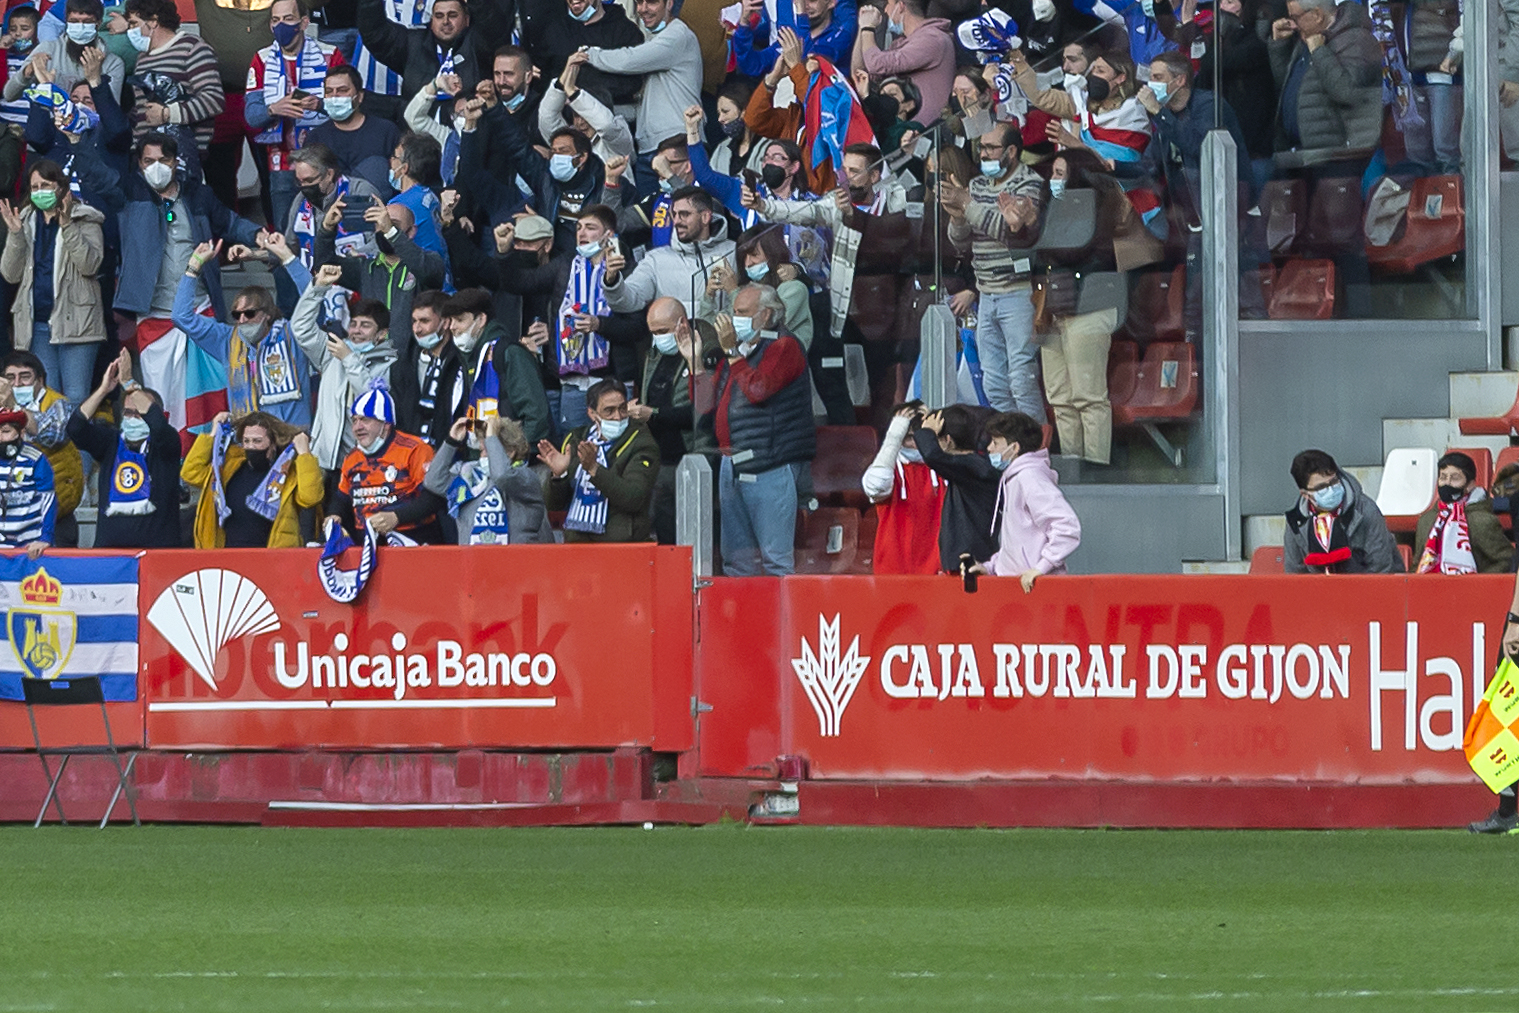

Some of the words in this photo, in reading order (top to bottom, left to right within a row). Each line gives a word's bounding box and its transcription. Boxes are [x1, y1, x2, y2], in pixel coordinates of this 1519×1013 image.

[274, 632, 432, 700] Unicaja
[437, 640, 557, 687] Banco
[880, 644, 982, 701] CAJA
[993, 644, 1136, 699] RURAL
[1146, 644, 1207, 699] DE
[1216, 644, 1351, 704] GIJON
[1368, 621, 1486, 751] Hal
